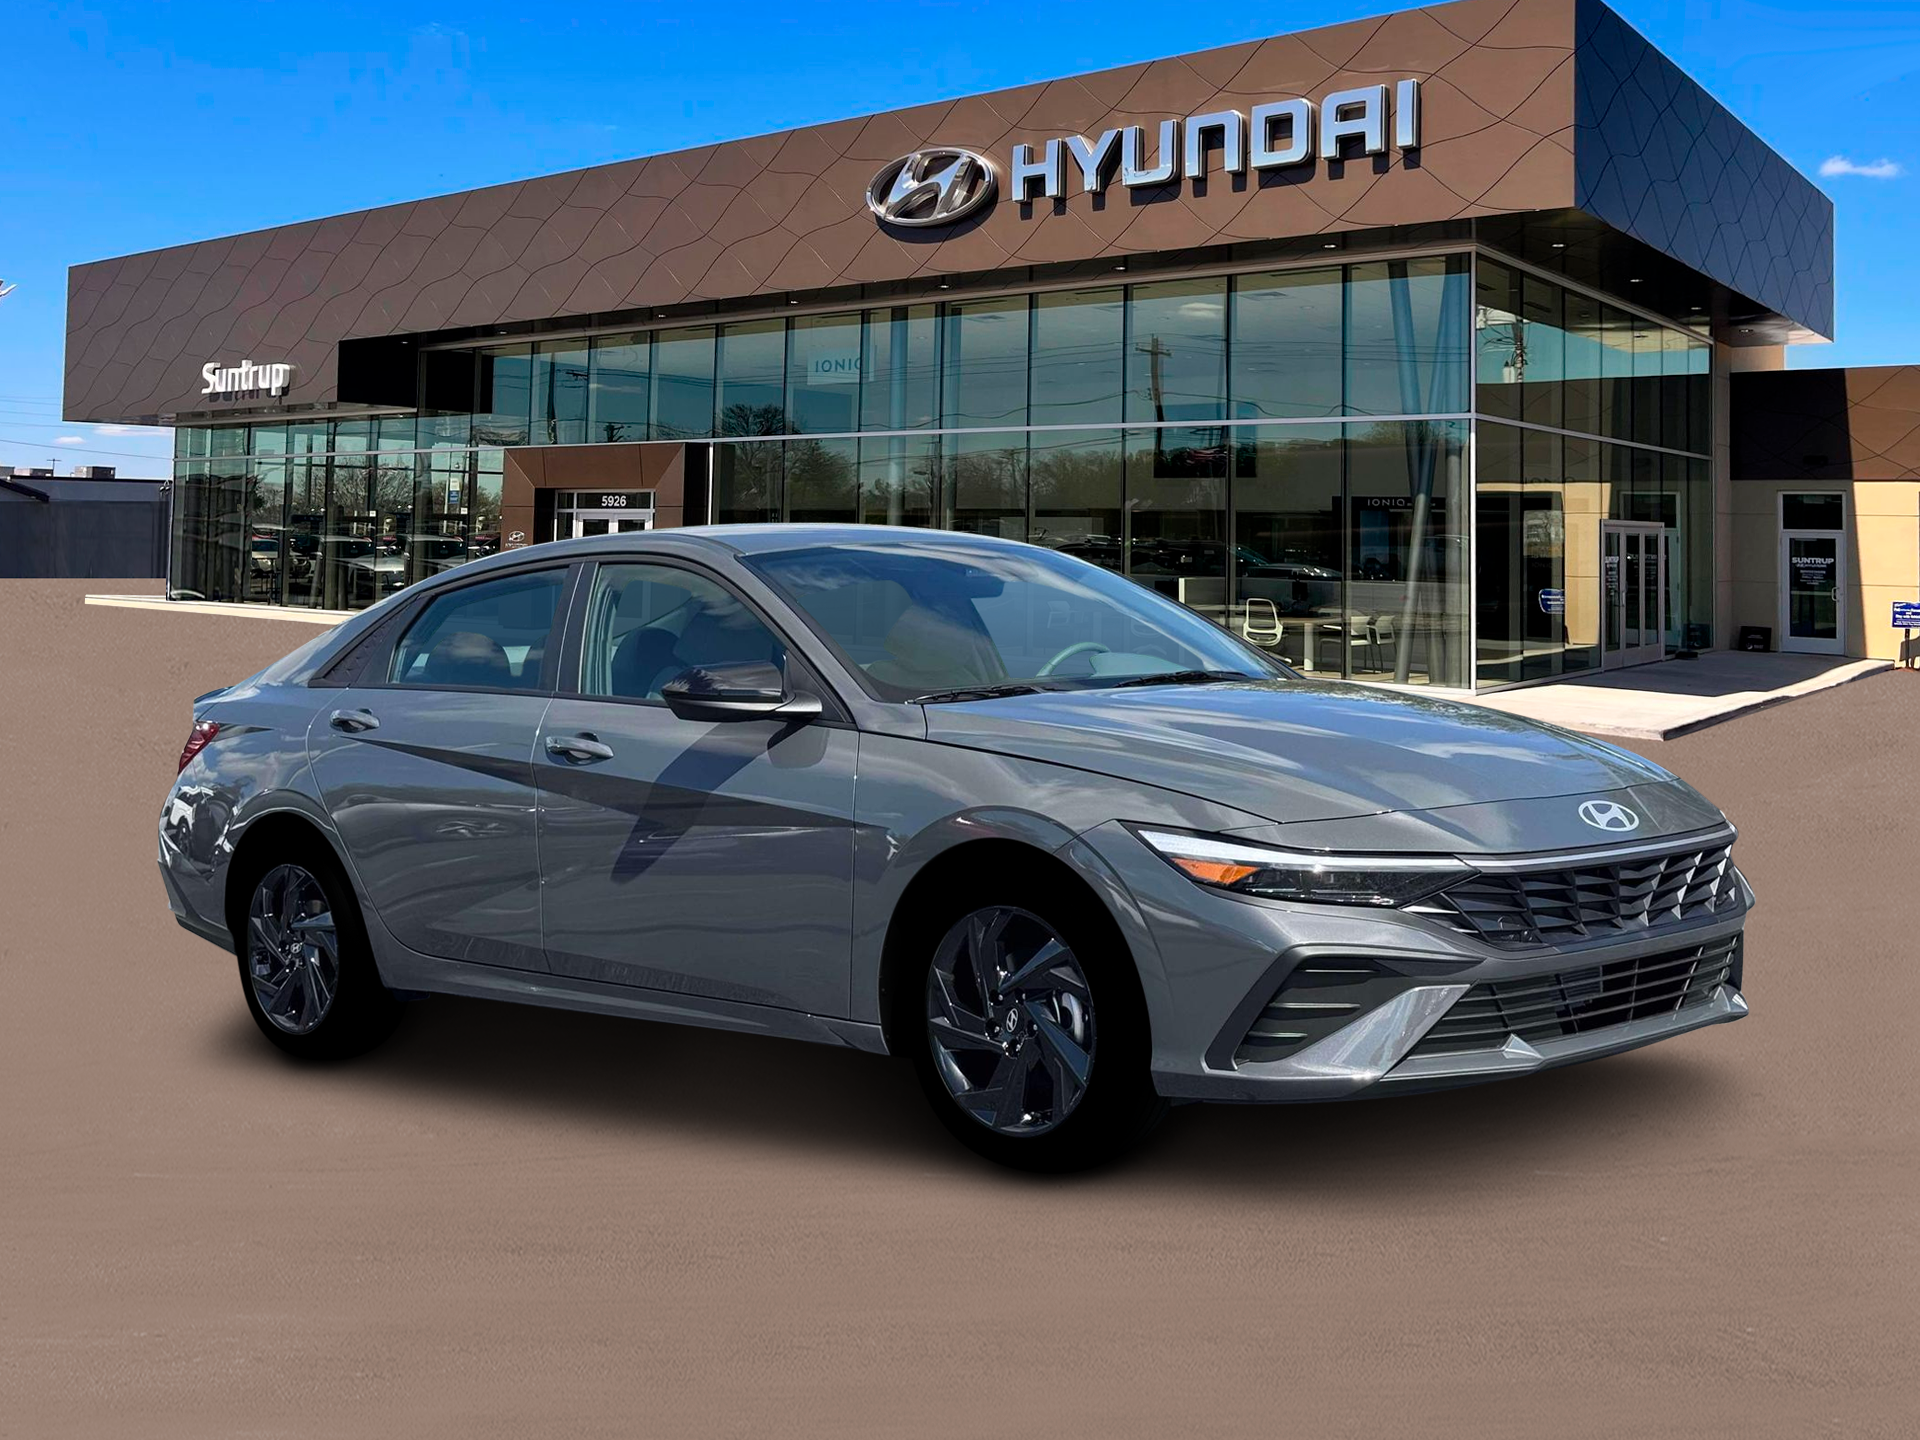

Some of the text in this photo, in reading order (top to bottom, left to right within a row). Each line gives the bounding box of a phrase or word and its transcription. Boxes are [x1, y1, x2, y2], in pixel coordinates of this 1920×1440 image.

[1012, 79, 1421, 203] HYUNDAI
[201, 360, 290, 396] Suntrup
[601, 495, 627, 507] 5926
